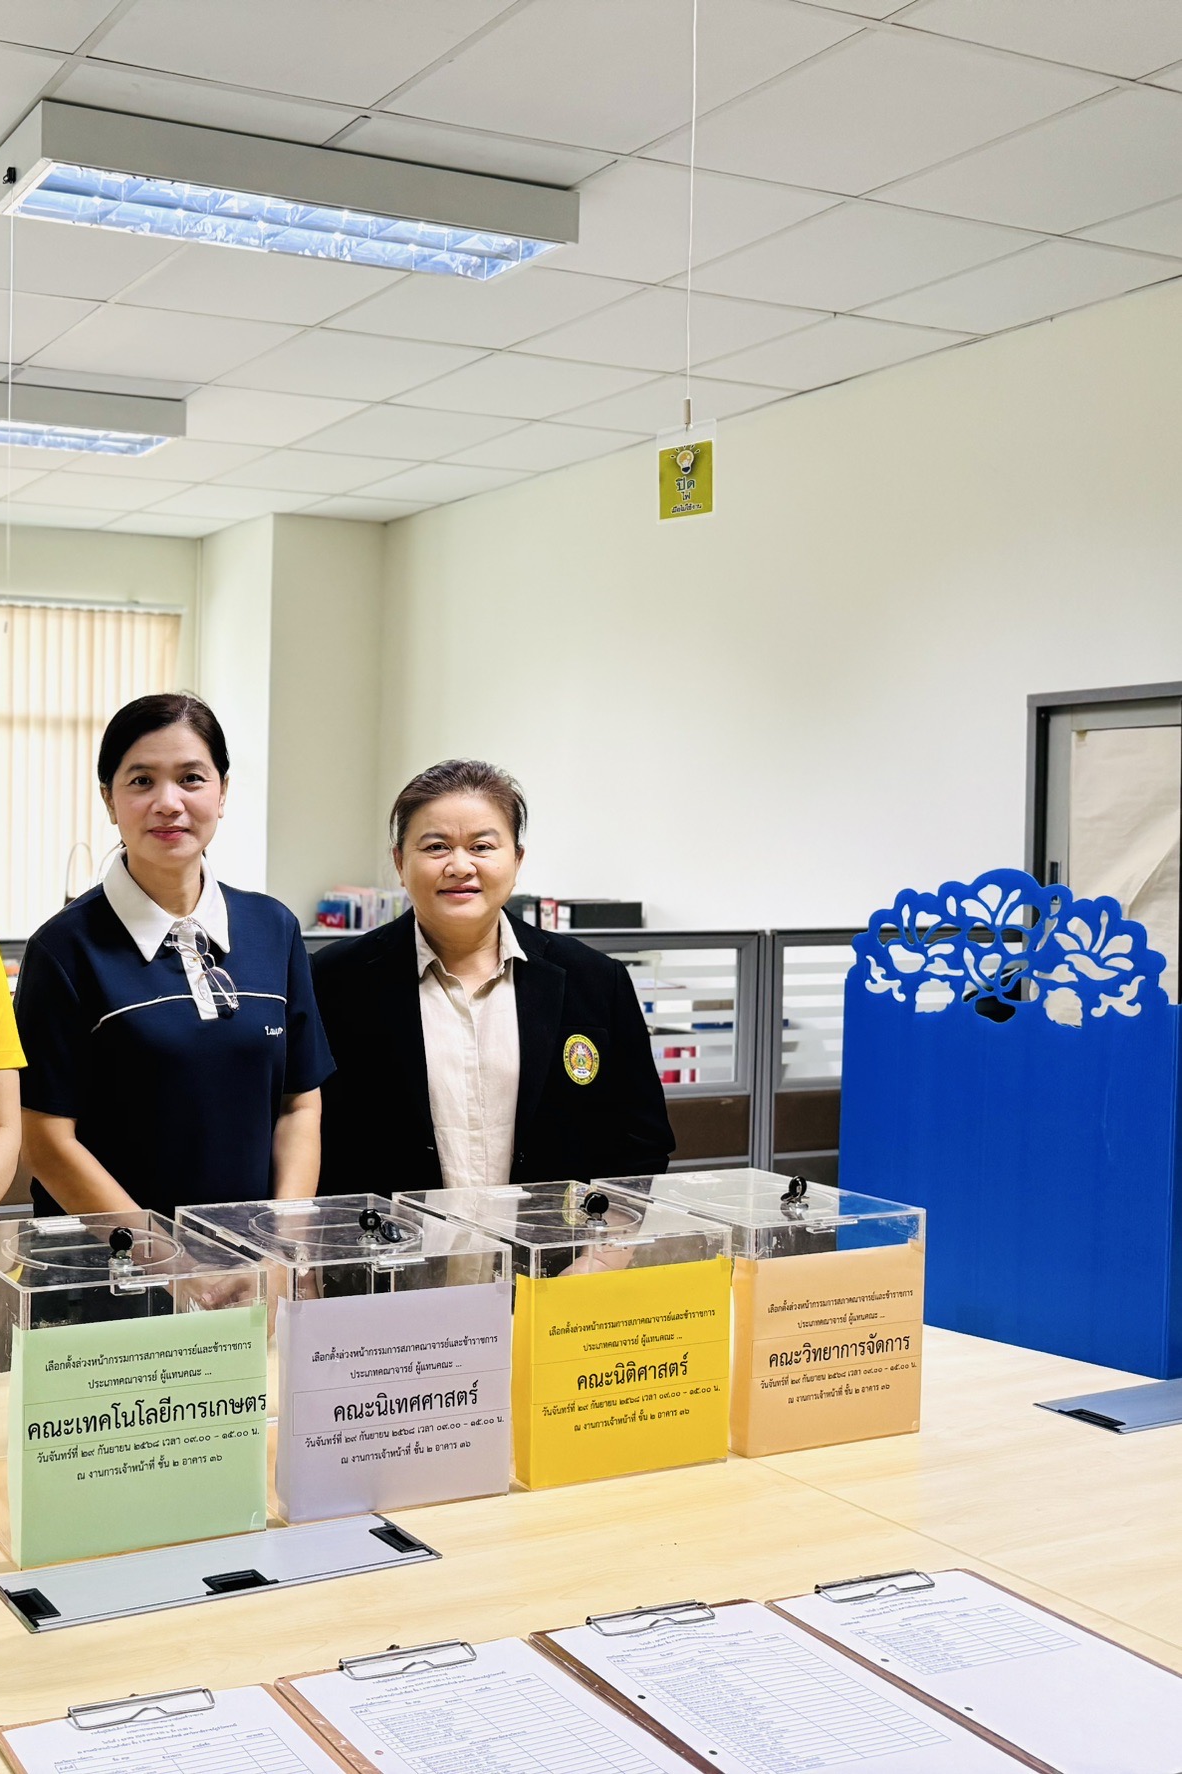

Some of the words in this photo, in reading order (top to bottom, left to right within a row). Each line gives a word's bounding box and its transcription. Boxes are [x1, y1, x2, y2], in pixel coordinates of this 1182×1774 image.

[46, 1340, 252, 1372] เลือกตั้งล่วงหน้ากรรมการสภาคณาจารย์และข้าราชการ
[769, 1333, 910, 1368] คณะวิทยาการจัดการ
[88, 1370, 157, 1390] ประเภทคณาจารย์
[160, 1368, 201, 1384] ผู้แทนคณะ
[350, 1362, 413, 1379] ประเภทคณาจารย์
[416, 1360, 452, 1376] ผู้แทนคณะ
[577, 1352, 689, 1391] คณะนิติศาสตร์
[334, 1380, 479, 1422] คณะนิเทศศาสตร์
[28, 1394, 267, 1441] คณะเทคโนโลยีการเกษตร
[359, 1426, 389, 1442] กันยายน
[418, 1423, 434, 1434] เวลา
[37, 1445, 78, 1463] วันจันทร์ที่
[81, 1449, 95, 1458] ๒๙
[97, 1442, 131, 1455] กันยายน
[162, 1437, 180, 1447] เวลา
[252, 1426, 259, 1435] น.
[351, 1443, 411, 1463] งานการเจ้าหน้าที่
[414, 1440, 424, 1454] ชั้น
[435, 1440, 457, 1452] อาคาร
[77, 1471, 85, 1480] ณ
[88, 1457, 155, 1479] งานการเจ้าหน้าที่
[158, 1452, 170, 1469] ชั้น
[182, 1452, 206, 1465] อาคาร
